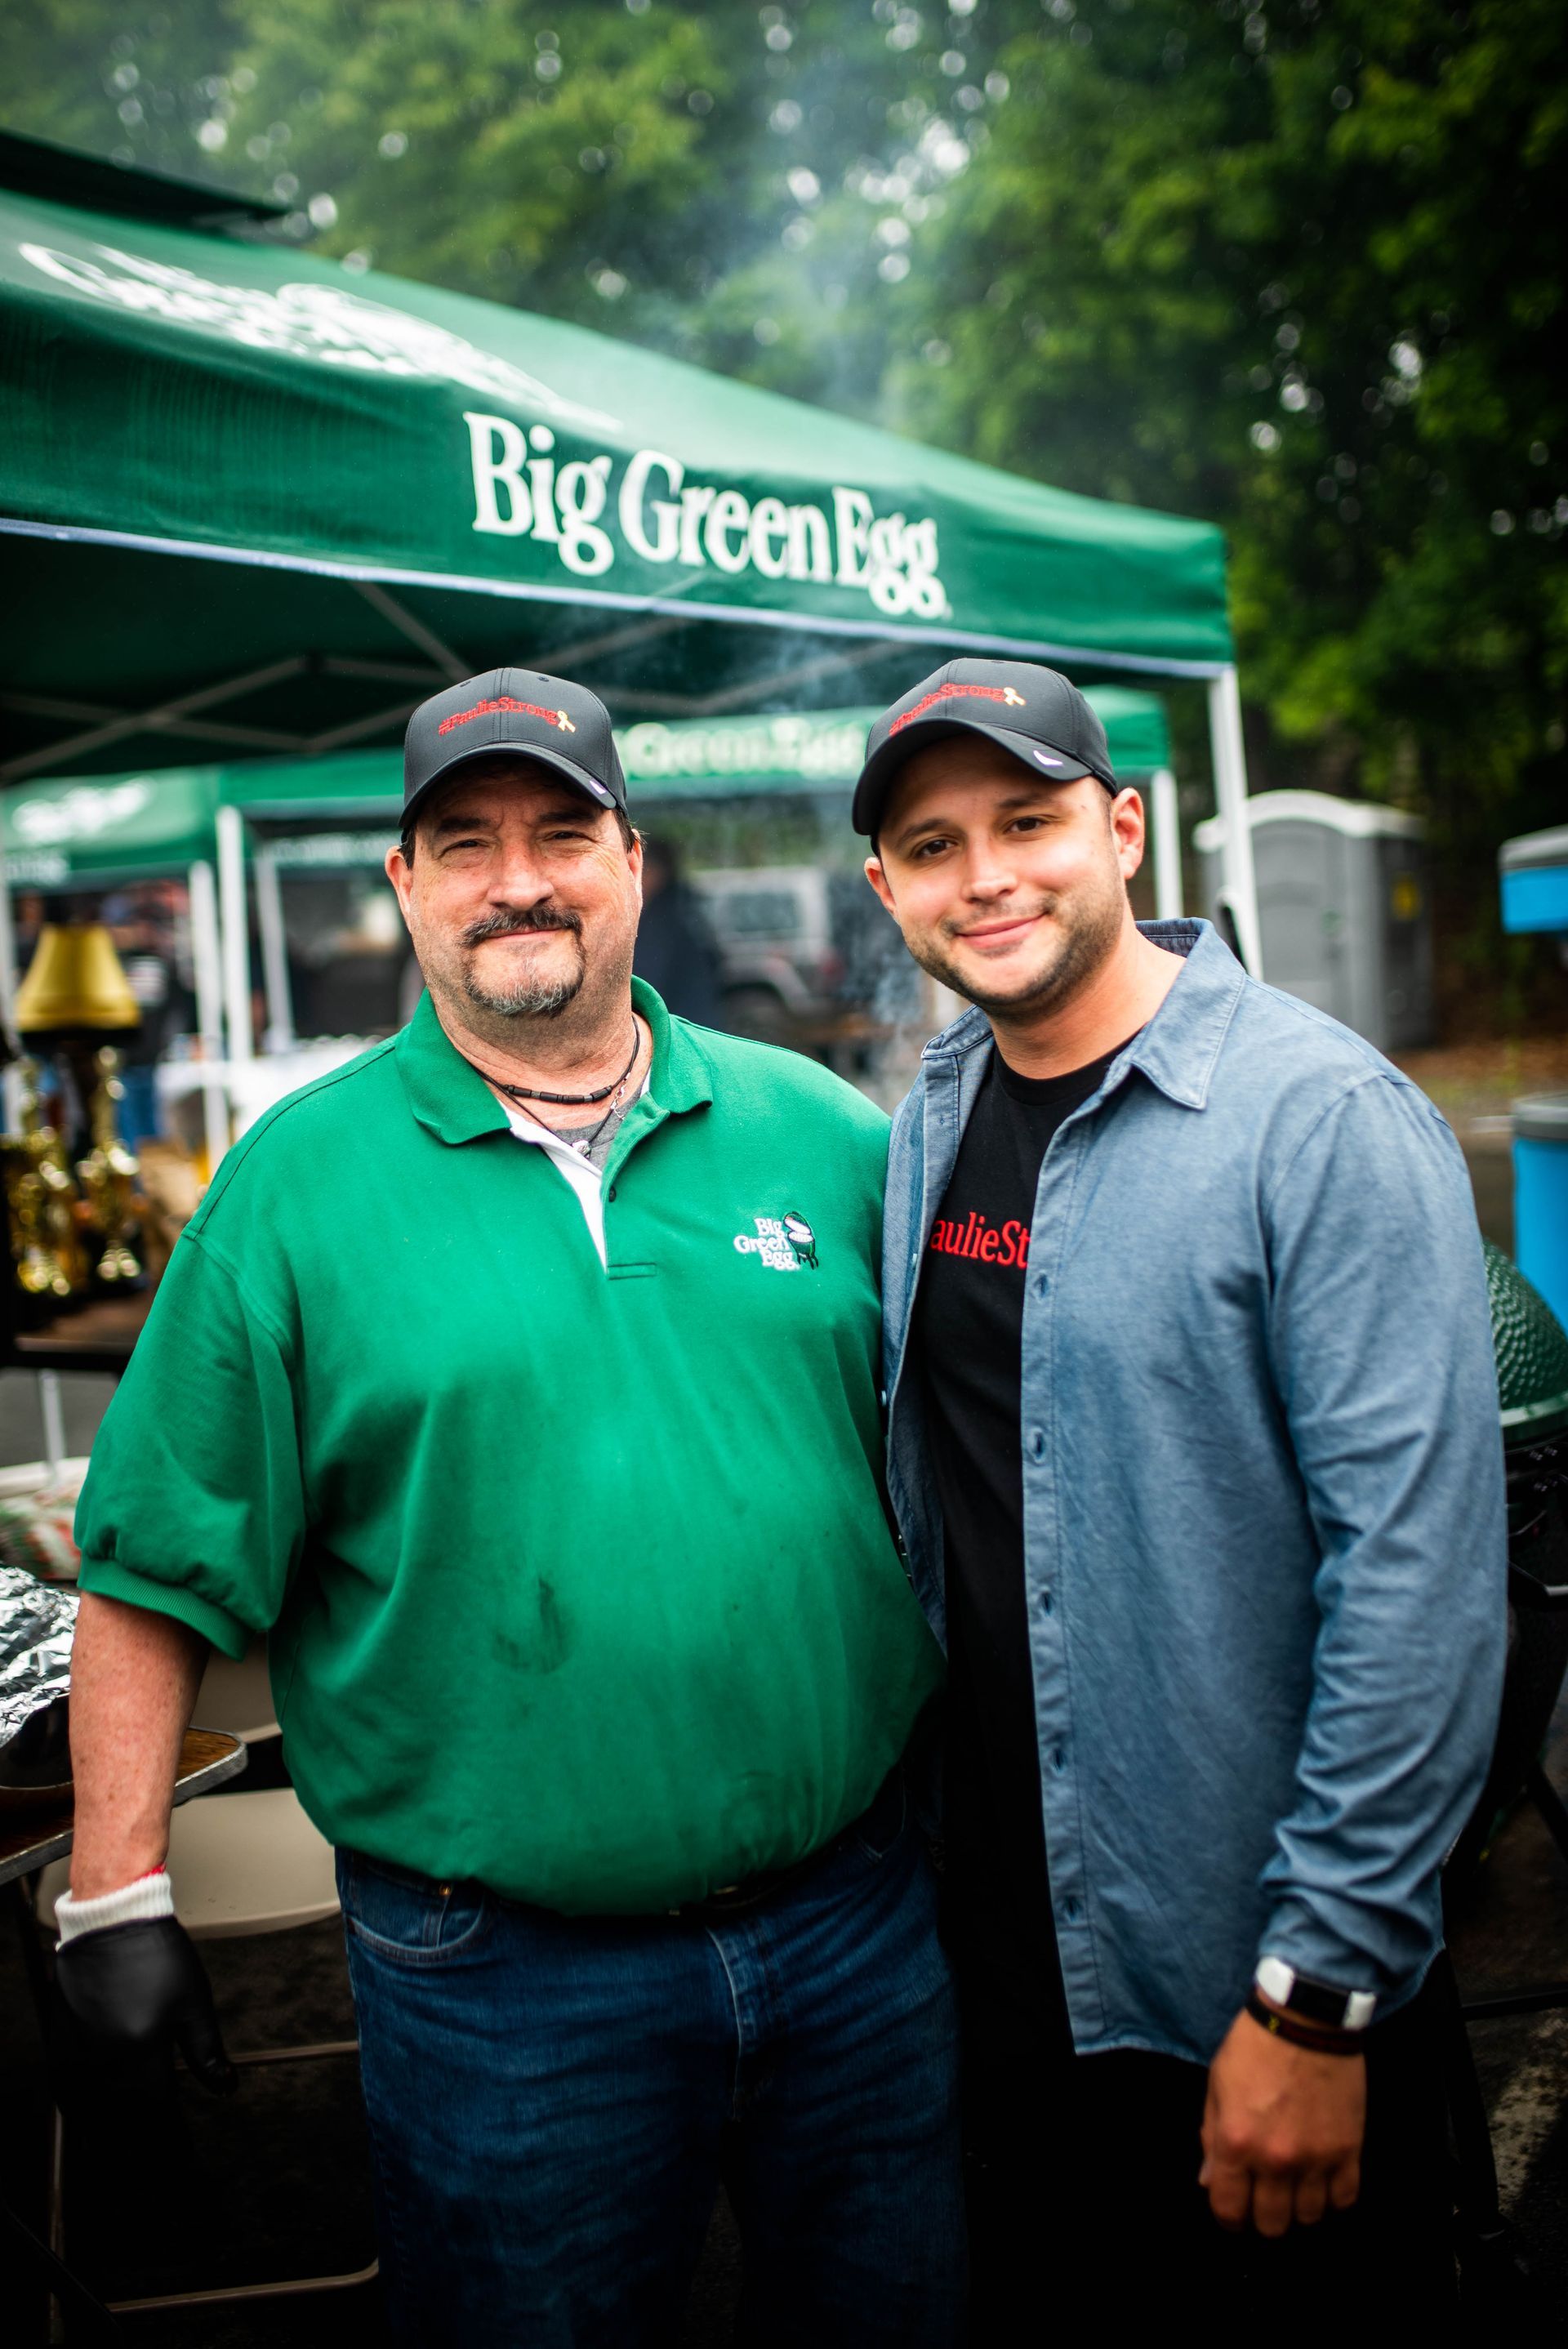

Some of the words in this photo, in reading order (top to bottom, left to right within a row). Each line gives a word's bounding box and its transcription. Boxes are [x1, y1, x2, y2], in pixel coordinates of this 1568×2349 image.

[463, 411, 615, 577] Big
[618, 449, 831, 583] Green
[832, 486, 947, 619] Egg
[439, 696, 559, 736] #PaulieStrong
[754, 1218, 786, 1239] Big
[930, 1212, 1031, 1269] aulieSt
[733, 1234, 791, 1254] Green
[760, 1250, 795, 1271] Egg
